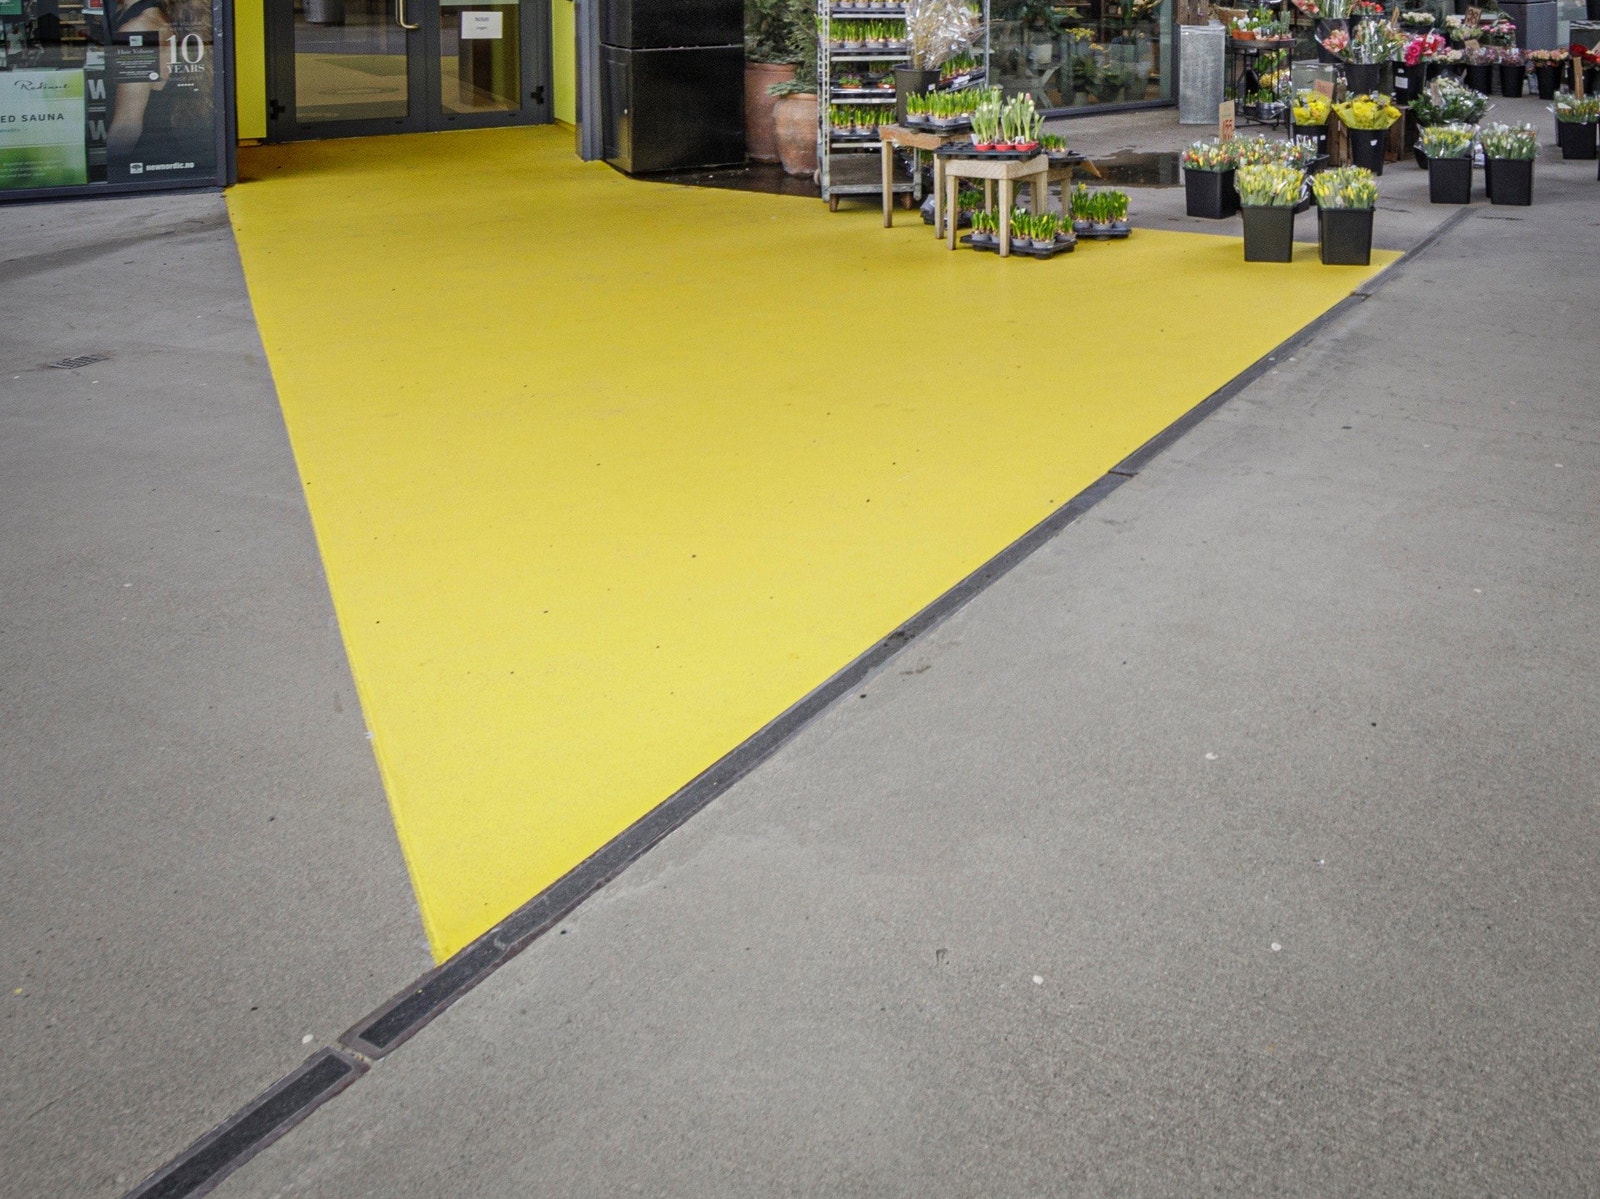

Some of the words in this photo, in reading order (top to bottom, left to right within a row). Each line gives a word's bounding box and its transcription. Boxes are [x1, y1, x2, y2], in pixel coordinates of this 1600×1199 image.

[165, 33, 205, 65] 10
[167, 64, 205, 74] YEARS
[21, 113, 65, 123] SAUNA
[145, 162, 195, 171] newnordic.no
